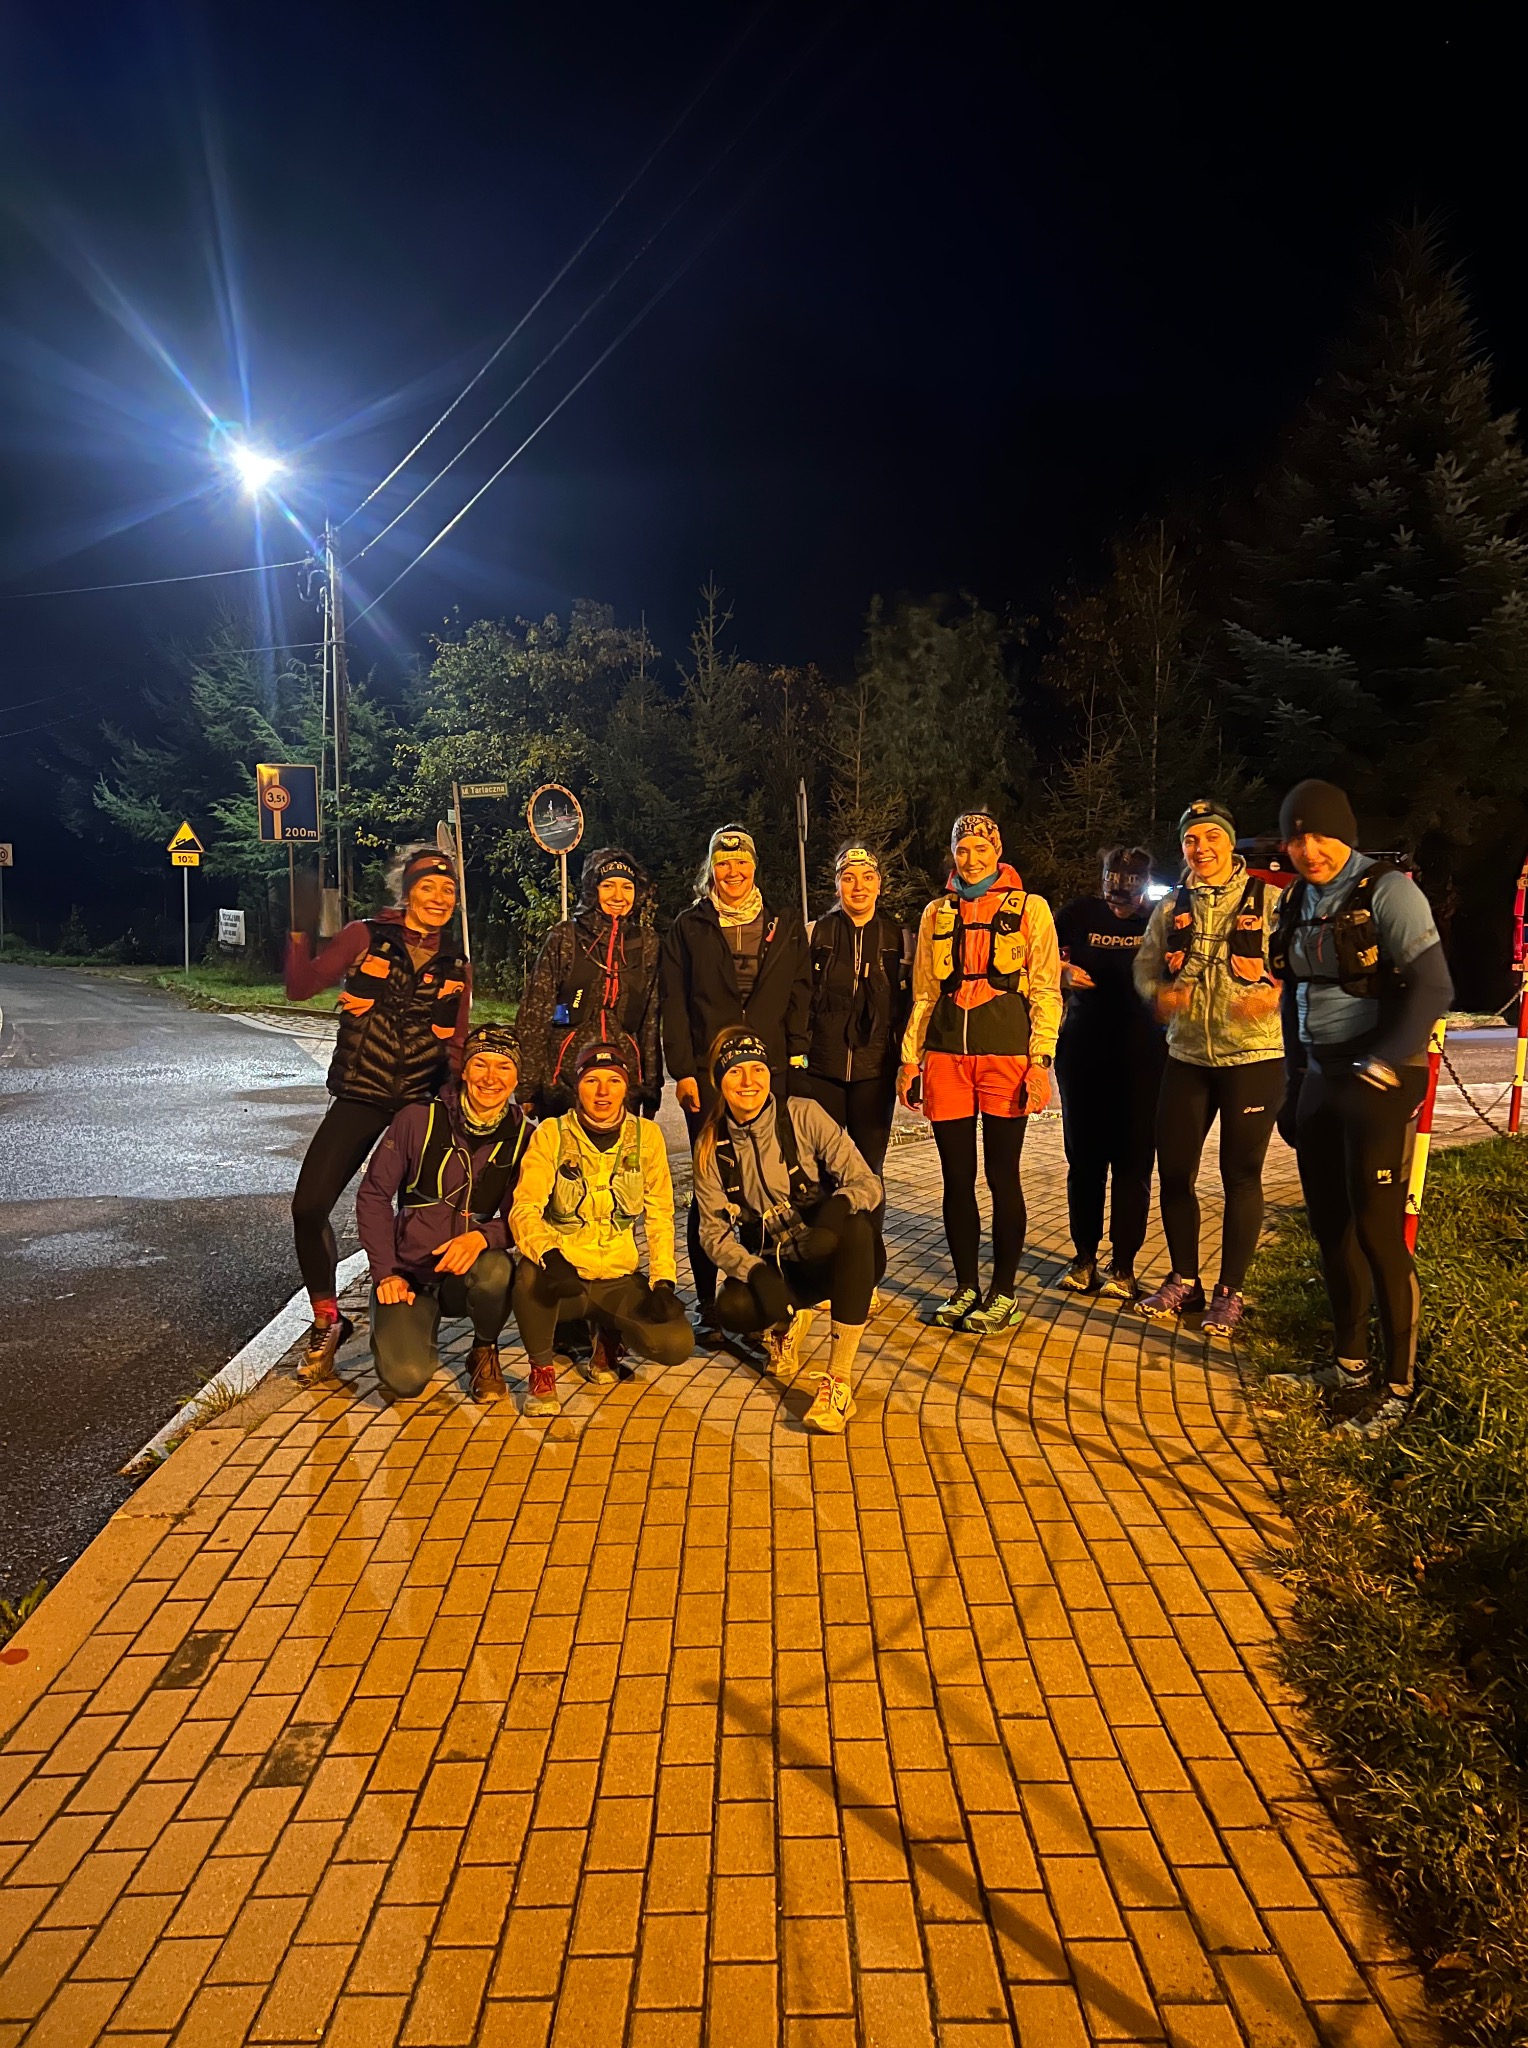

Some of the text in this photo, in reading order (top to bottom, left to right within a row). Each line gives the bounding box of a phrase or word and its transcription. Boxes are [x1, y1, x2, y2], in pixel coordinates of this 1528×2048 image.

[267, 792, 286, 803] 3,5t
[285, 827, 317, 838] 200m
[178, 855, 194, 864] 10%
